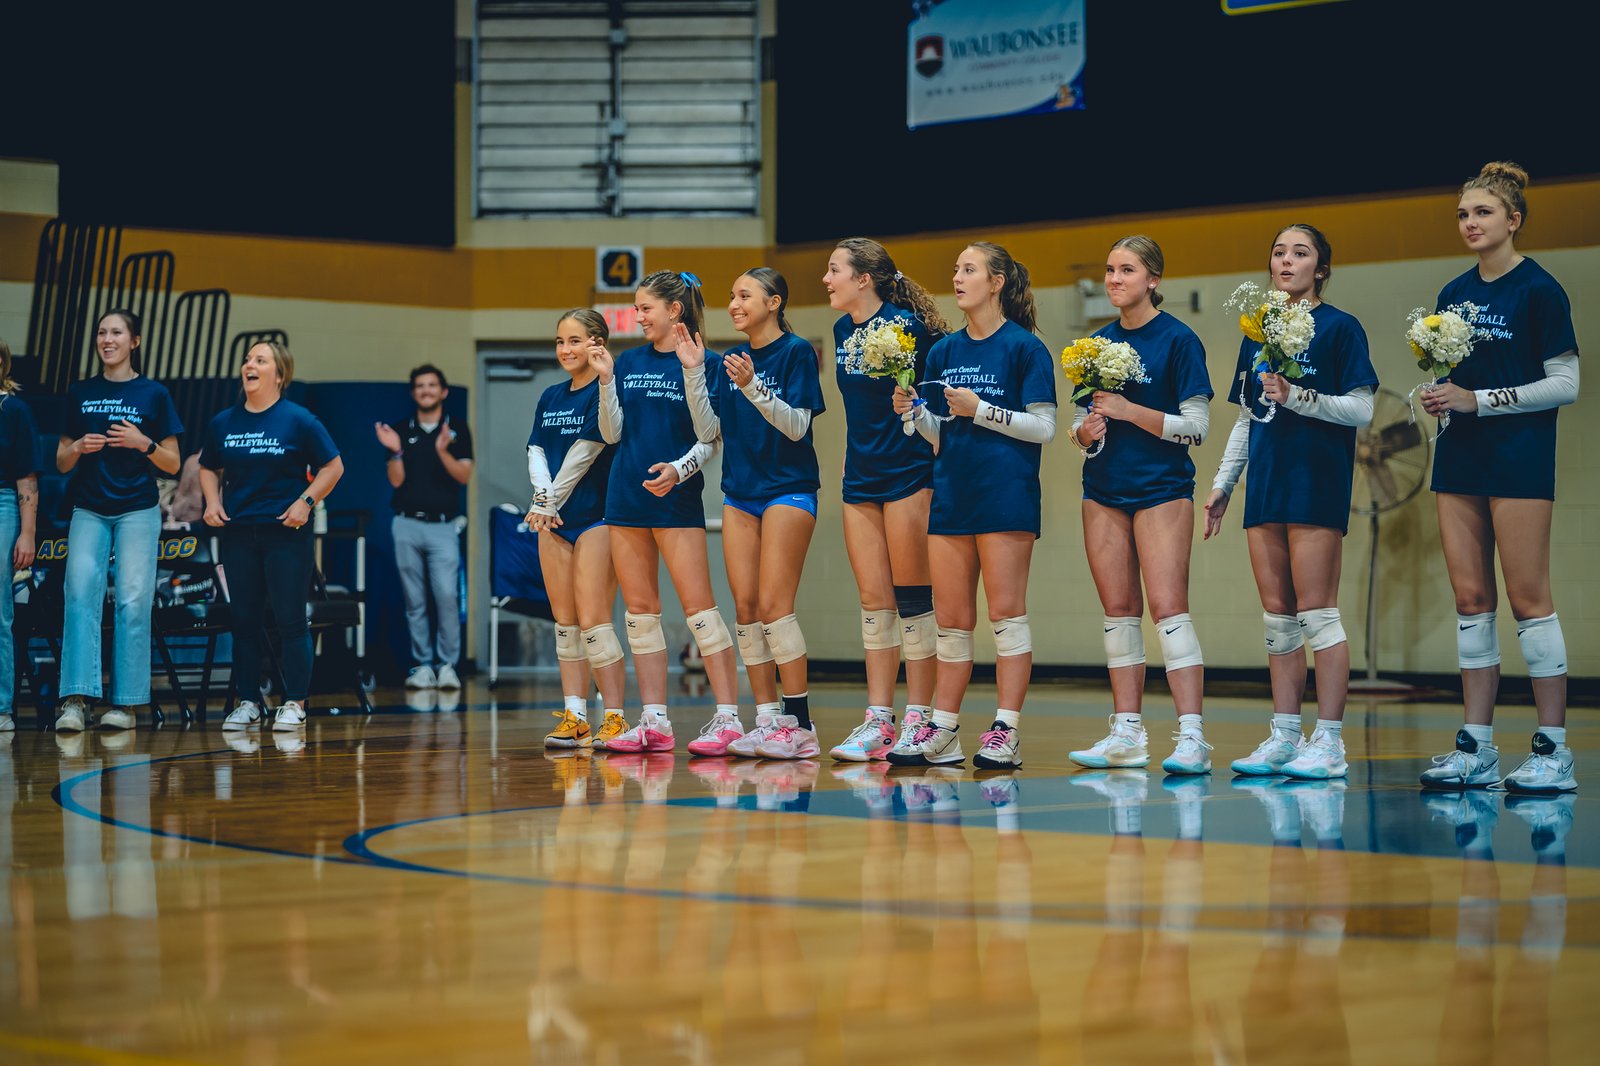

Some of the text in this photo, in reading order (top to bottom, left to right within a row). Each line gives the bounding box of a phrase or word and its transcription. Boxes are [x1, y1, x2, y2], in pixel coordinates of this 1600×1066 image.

[950, 21, 1078, 59] WAUBONSEE
[608, 253, 631, 285] 4
[604, 307, 638, 333] EXIT
[1490, 327, 1513, 339] Night
[958, 364, 981, 373] Central
[643, 372, 665, 380] Central
[623, 380, 679, 390] VOLLEYBALL
[664, 391, 684, 401] Night
[984, 386, 1005, 396] Night
[1487, 388, 1518, 407] ACC
[81, 405, 139, 415] VOLLEYBALL
[986, 406, 1013, 427] ACC
[244, 431, 265, 439] Central
[224, 438, 280, 448] VOLLEYBALL
[267, 447, 285, 456] Night
[681, 455, 699, 477] ACC
